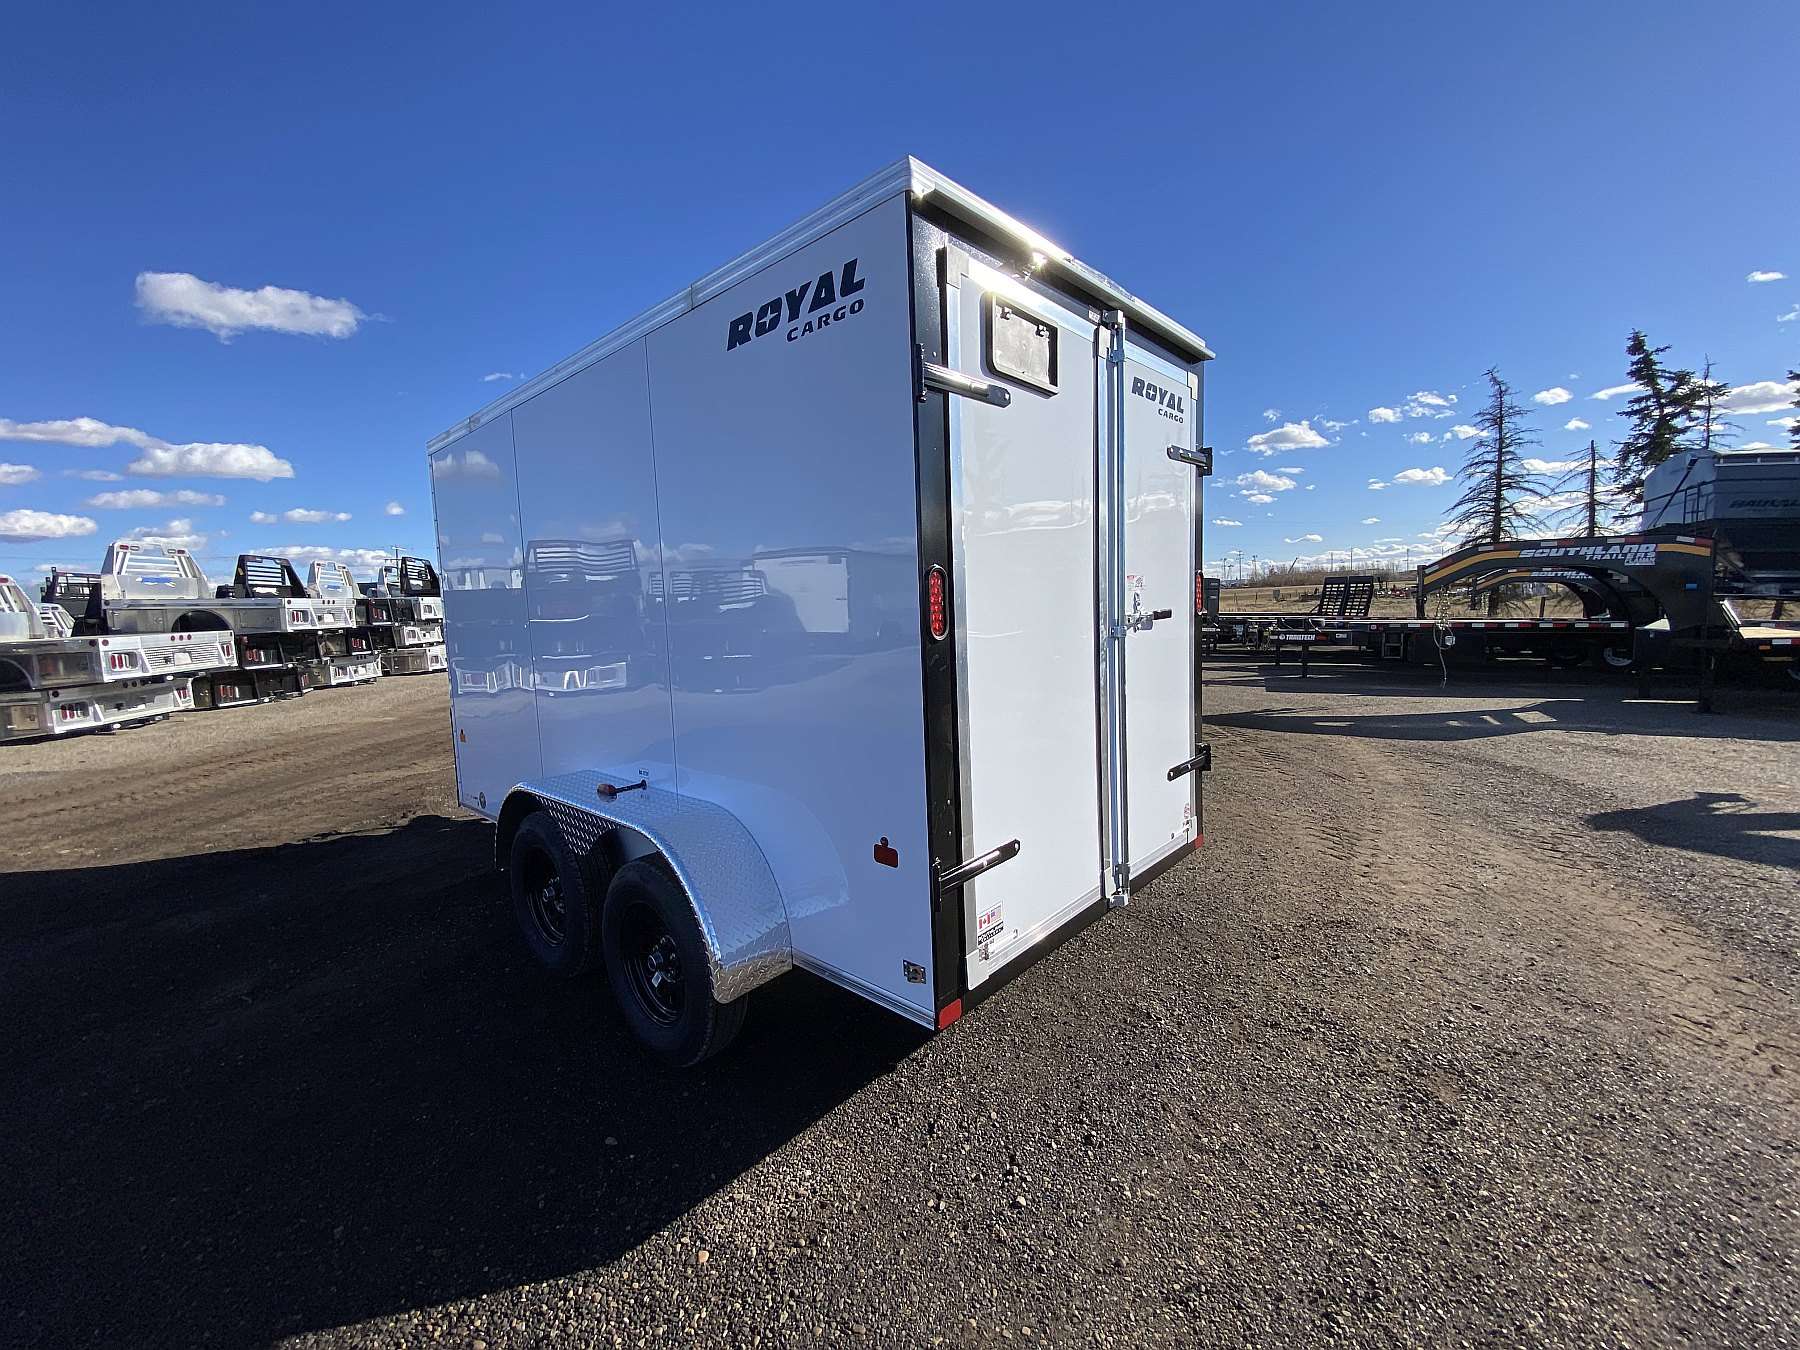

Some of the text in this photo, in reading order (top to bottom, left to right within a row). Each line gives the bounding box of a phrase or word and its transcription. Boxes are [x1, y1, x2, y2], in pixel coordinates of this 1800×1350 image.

[726, 257, 866, 352] ROYAL
[786, 298, 865, 342] CARGO
[1131, 376, 1185, 414] ROYAL
[1158, 408, 1184, 424] CARGO
[1519, 543, 1656, 558] SOUTHLAND
[1585, 551, 1656, 561] TRAILERS
